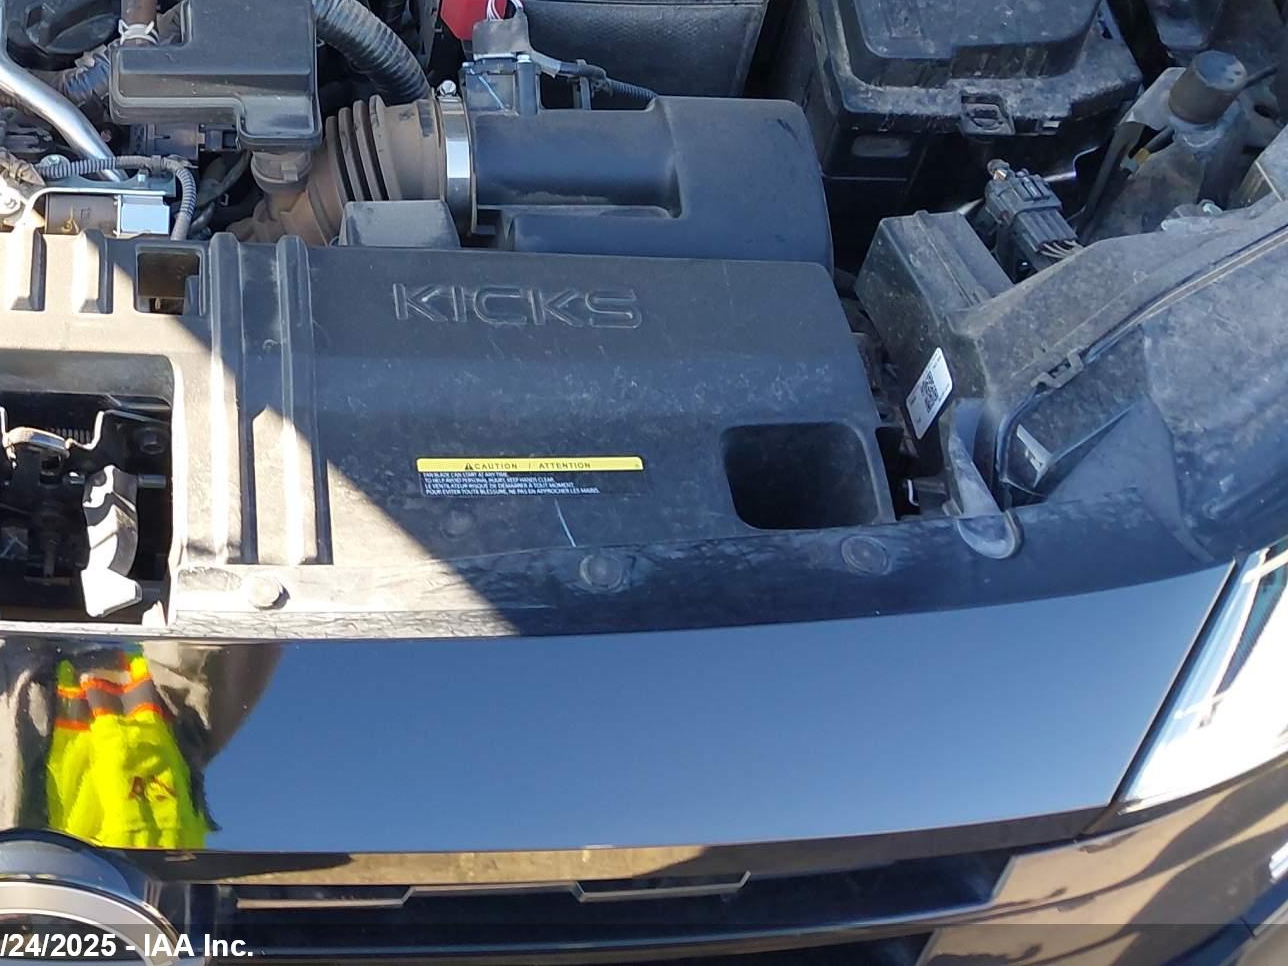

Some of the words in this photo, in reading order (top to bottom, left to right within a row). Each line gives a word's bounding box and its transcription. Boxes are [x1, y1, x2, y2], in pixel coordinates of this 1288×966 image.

[392, 282, 643, 329] KICKS
[474, 462, 518, 470] CAUTION
[538, 461, 591, 469] ATTENTION
